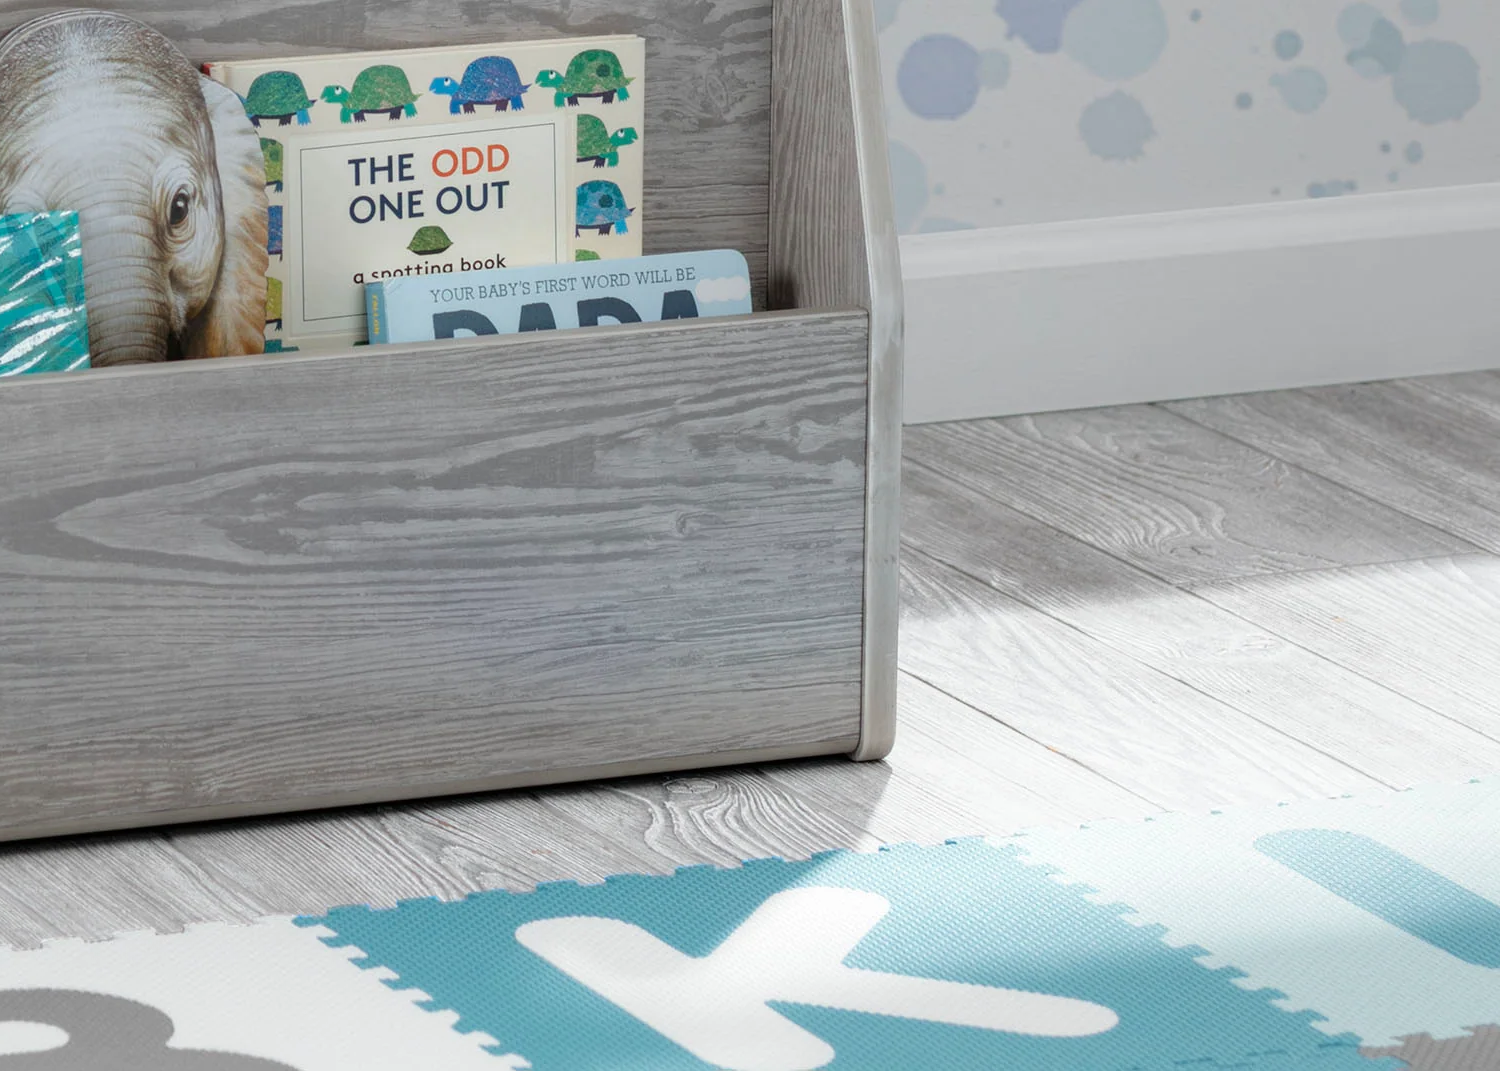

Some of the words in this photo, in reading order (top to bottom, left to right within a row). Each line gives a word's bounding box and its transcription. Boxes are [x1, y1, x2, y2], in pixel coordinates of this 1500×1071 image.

[348, 153, 414, 186] THE
[432, 144, 509, 177] ODD
[349, 190, 424, 224] ONE
[436, 180, 509, 214] OUT
[353, 272, 364, 284] a
[460, 254, 507, 272] book
[430, 286, 475, 303] YOUR
[478, 280, 531, 299] BABY'S
[535, 277, 577, 294] FIRST
[581, 273, 630, 290] WORD
[635, 269, 672, 284] WILL
[676, 267, 696, 281] BE
